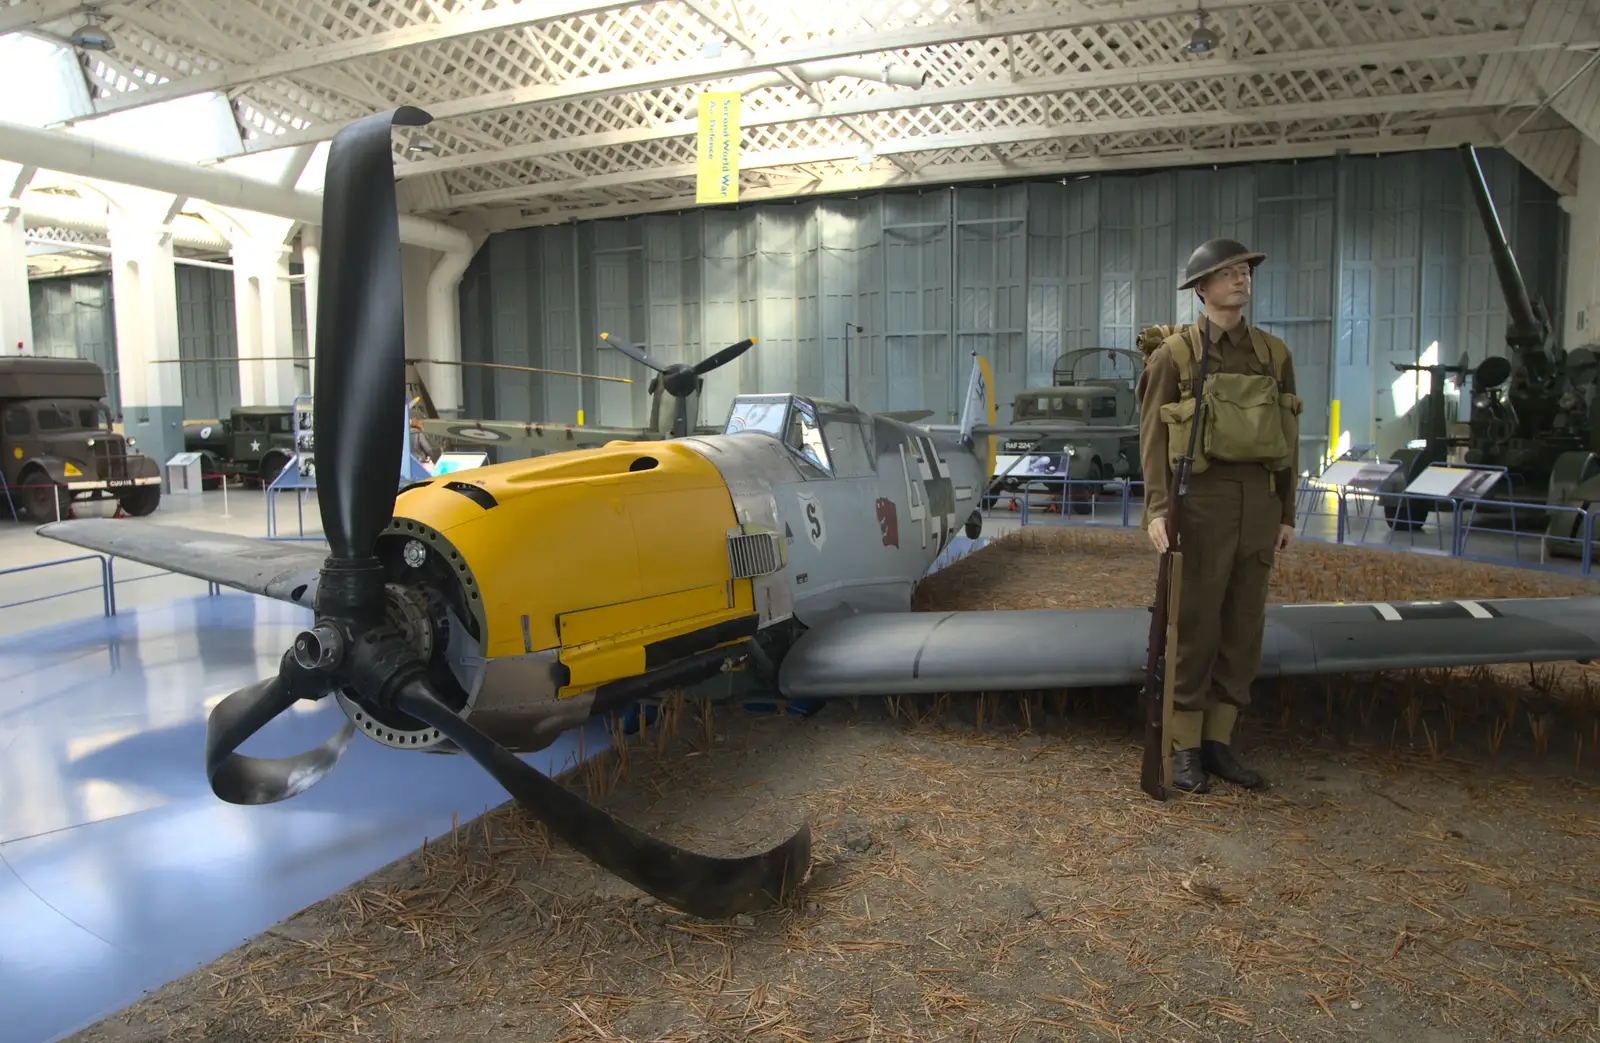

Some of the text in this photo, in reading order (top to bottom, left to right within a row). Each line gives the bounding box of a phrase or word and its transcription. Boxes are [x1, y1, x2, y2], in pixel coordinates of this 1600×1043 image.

[721, 99, 731, 196] Second World War
[806, 503, 821, 542] S
